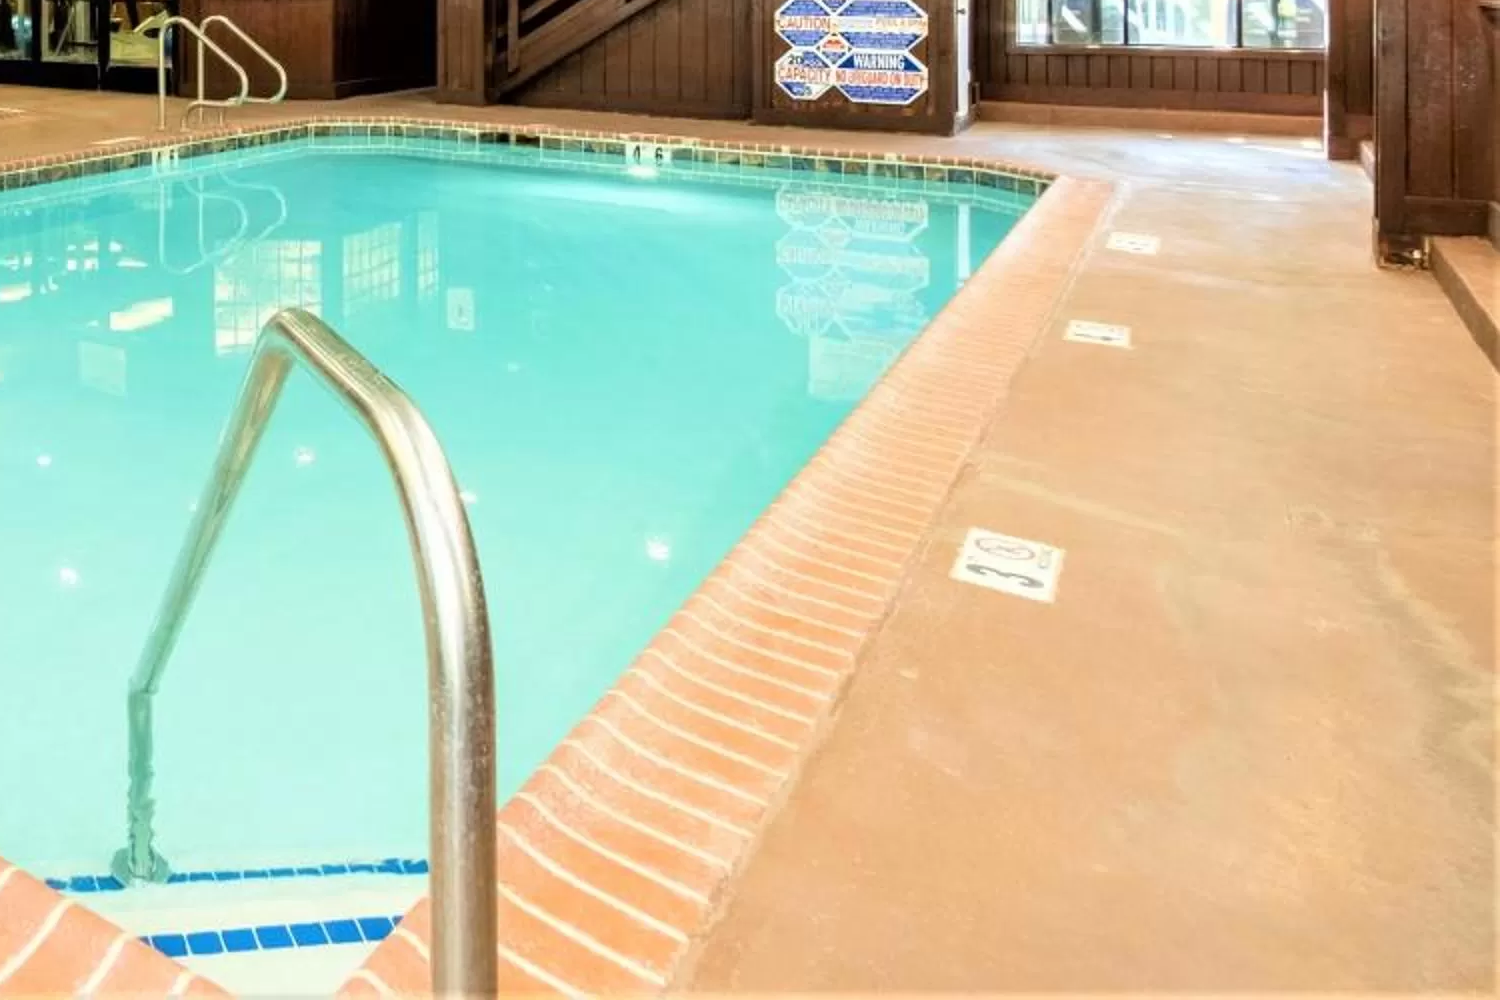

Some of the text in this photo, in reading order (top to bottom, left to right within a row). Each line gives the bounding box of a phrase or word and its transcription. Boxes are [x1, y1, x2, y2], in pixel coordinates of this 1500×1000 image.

[778, 16, 830, 29] CAUTION
[853, 54, 905, 69] WARNING
[779, 66, 831, 83] CAPACITY
